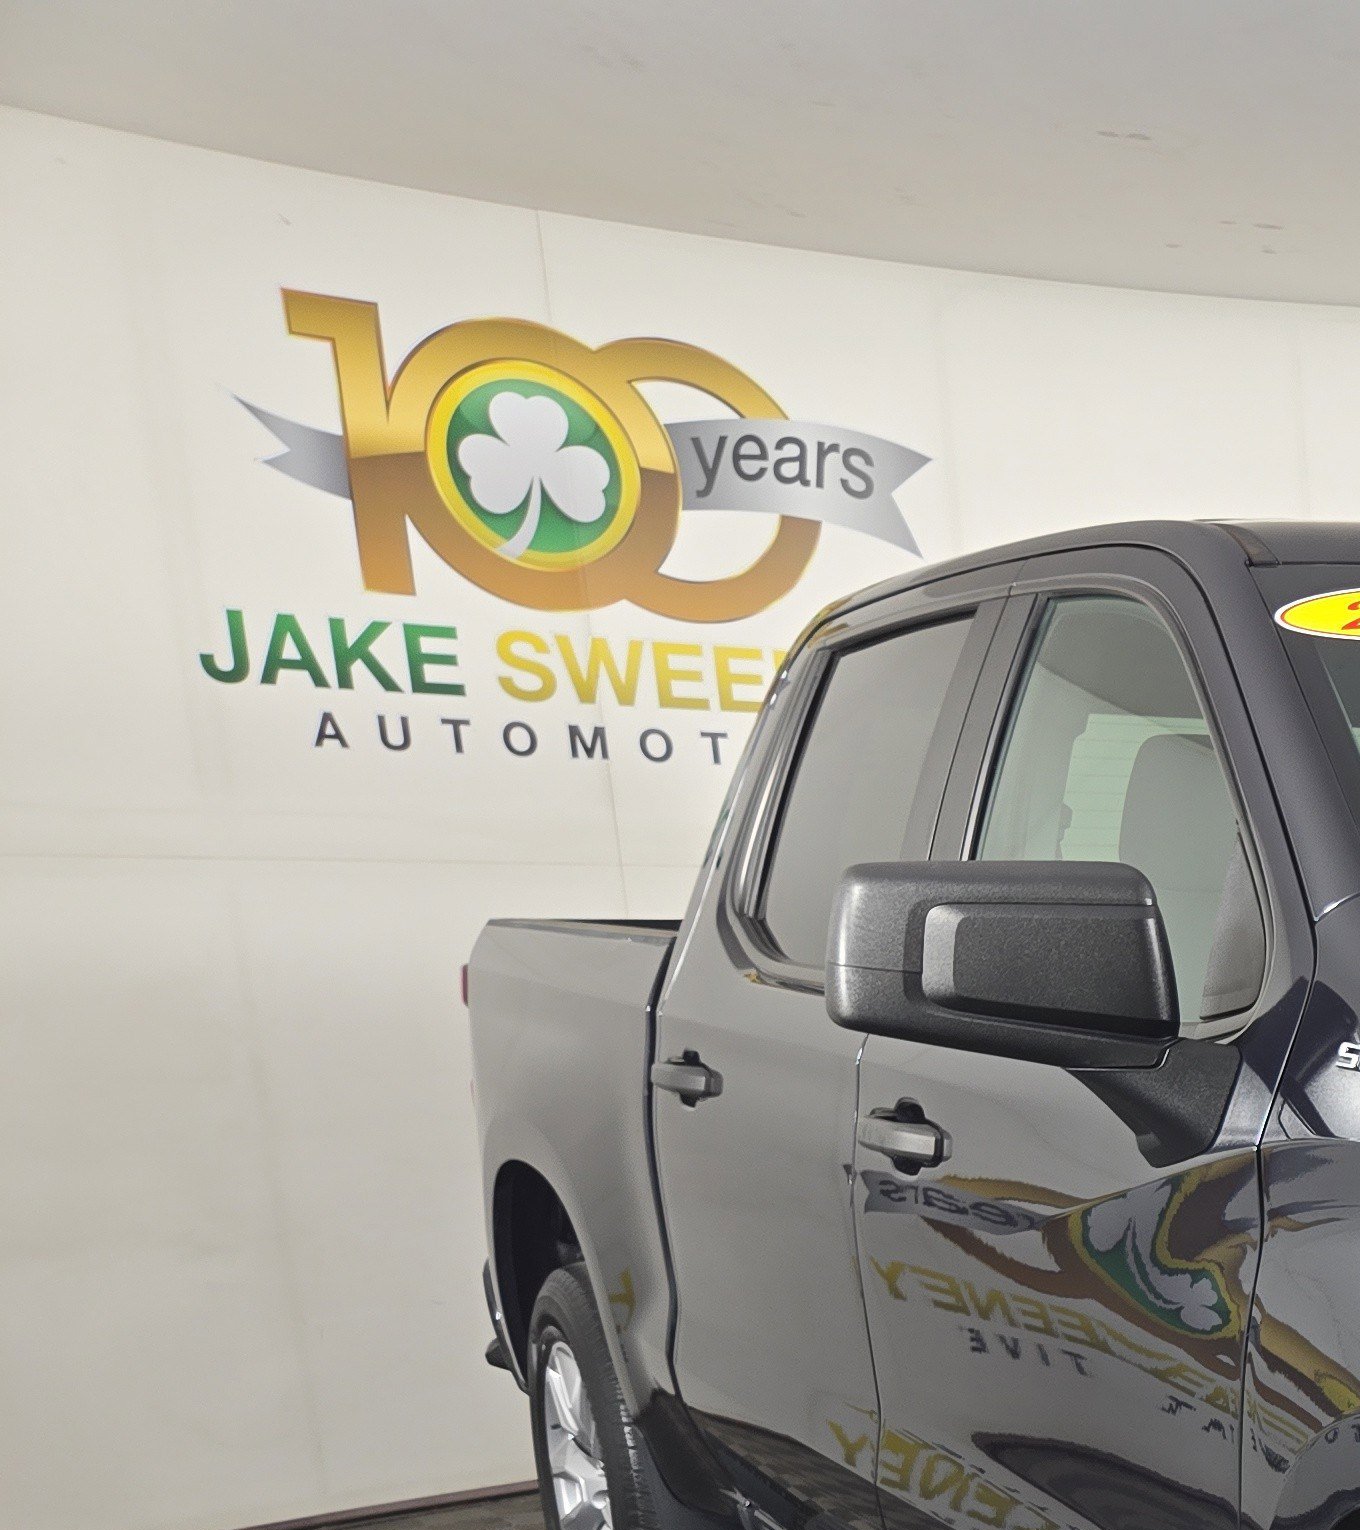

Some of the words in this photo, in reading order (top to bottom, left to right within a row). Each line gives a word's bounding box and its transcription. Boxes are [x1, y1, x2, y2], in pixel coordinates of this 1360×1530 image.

[690, 433, 876, 501] years
[199, 608, 467, 697] JAKE
[497, 630, 788, 713] SWEE
[314, 711, 730, 767] AUTOMOT
